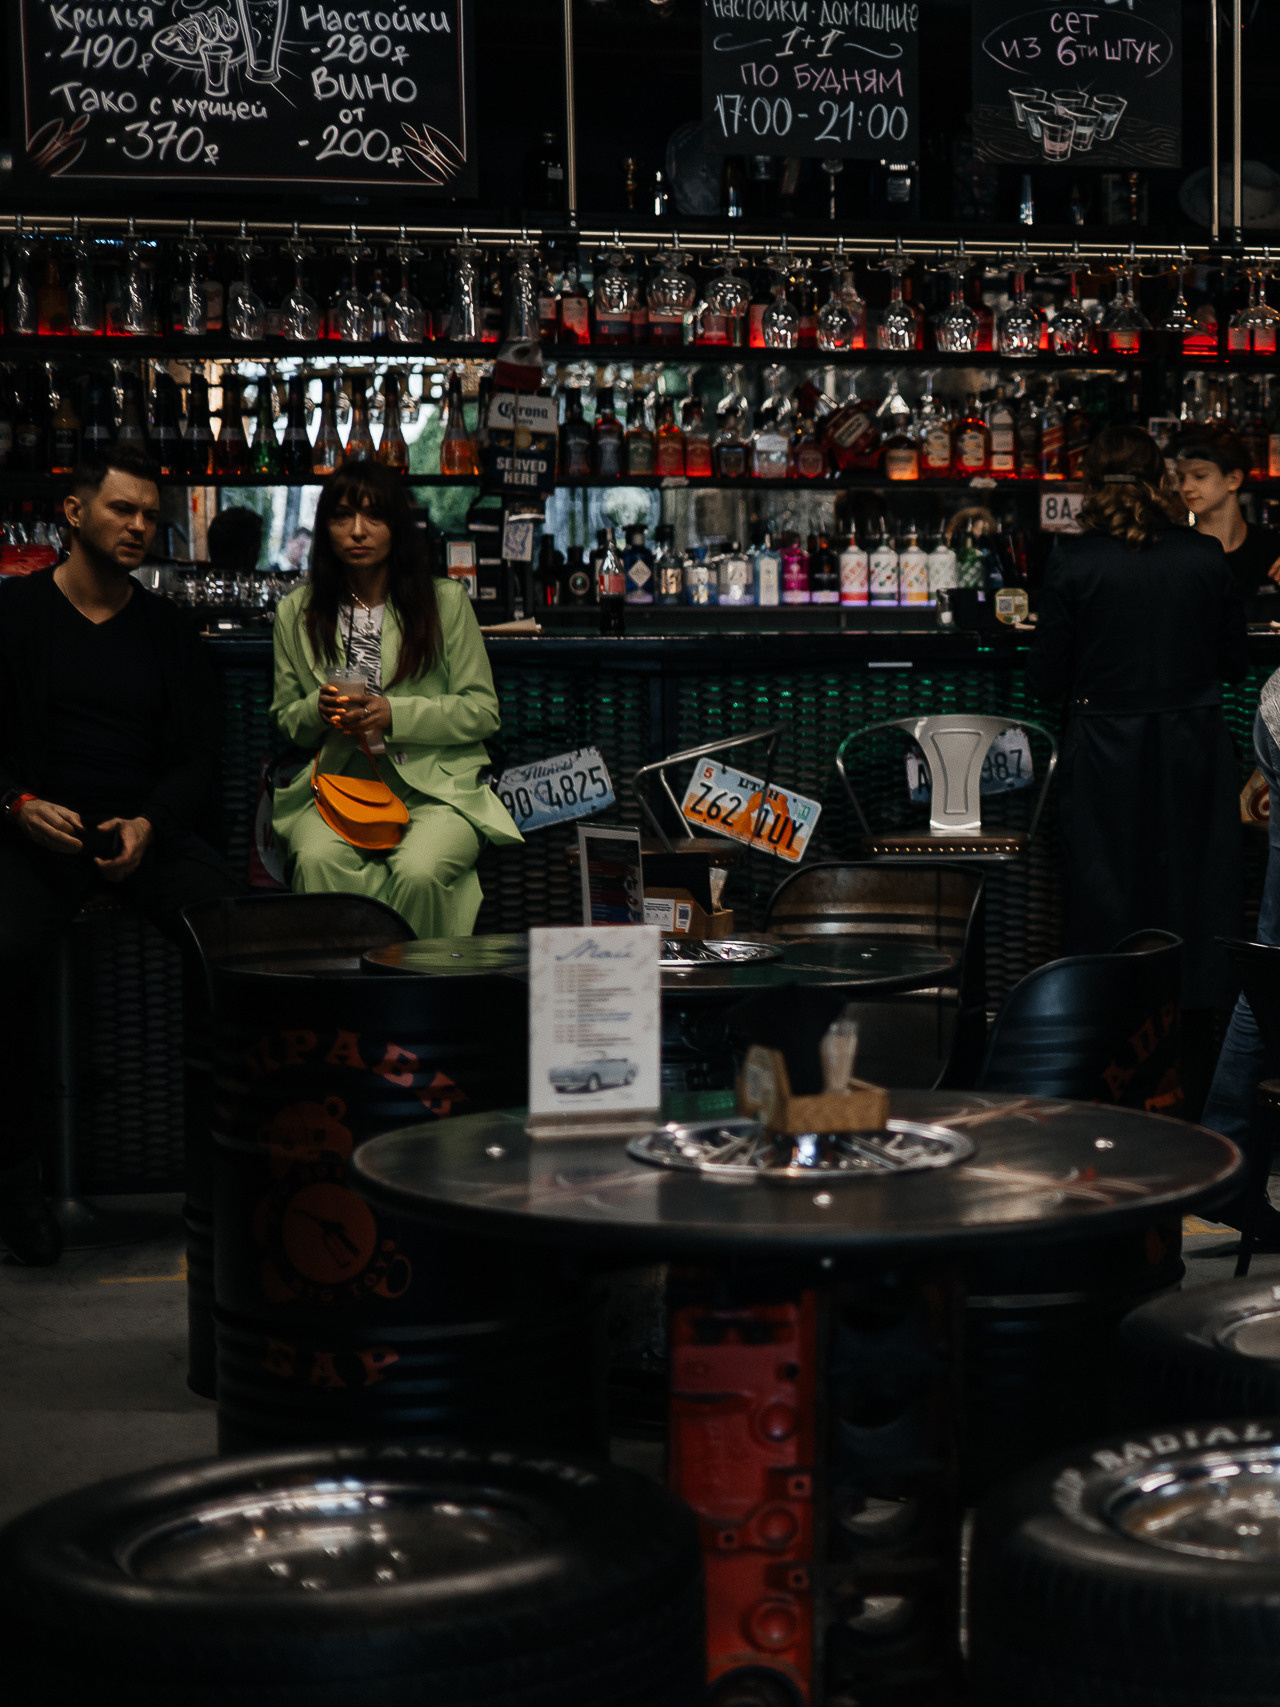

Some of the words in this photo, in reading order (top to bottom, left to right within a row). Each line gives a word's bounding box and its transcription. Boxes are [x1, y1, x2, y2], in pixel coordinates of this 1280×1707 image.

[50, 4, 155, 34] Крылья
[300, 4, 451, 33] Настойки
[775, 26, 846, 58] 1+1
[793, 63, 904, 98] БУДНЯМ
[50, 80, 138, 114] Тако
[171, 98, 268, 122] курицей
[338, 107, 366, 124] от
[496, 456, 547, 473] SERVED
[503, 471, 538, 486] HERE
[546, 765, 608, 810] 4825
[703, 767, 715, 779] 5
[261, 1336, 400, 1388] БАР
[1091, 1423, 1274, 1472] RADIAL
